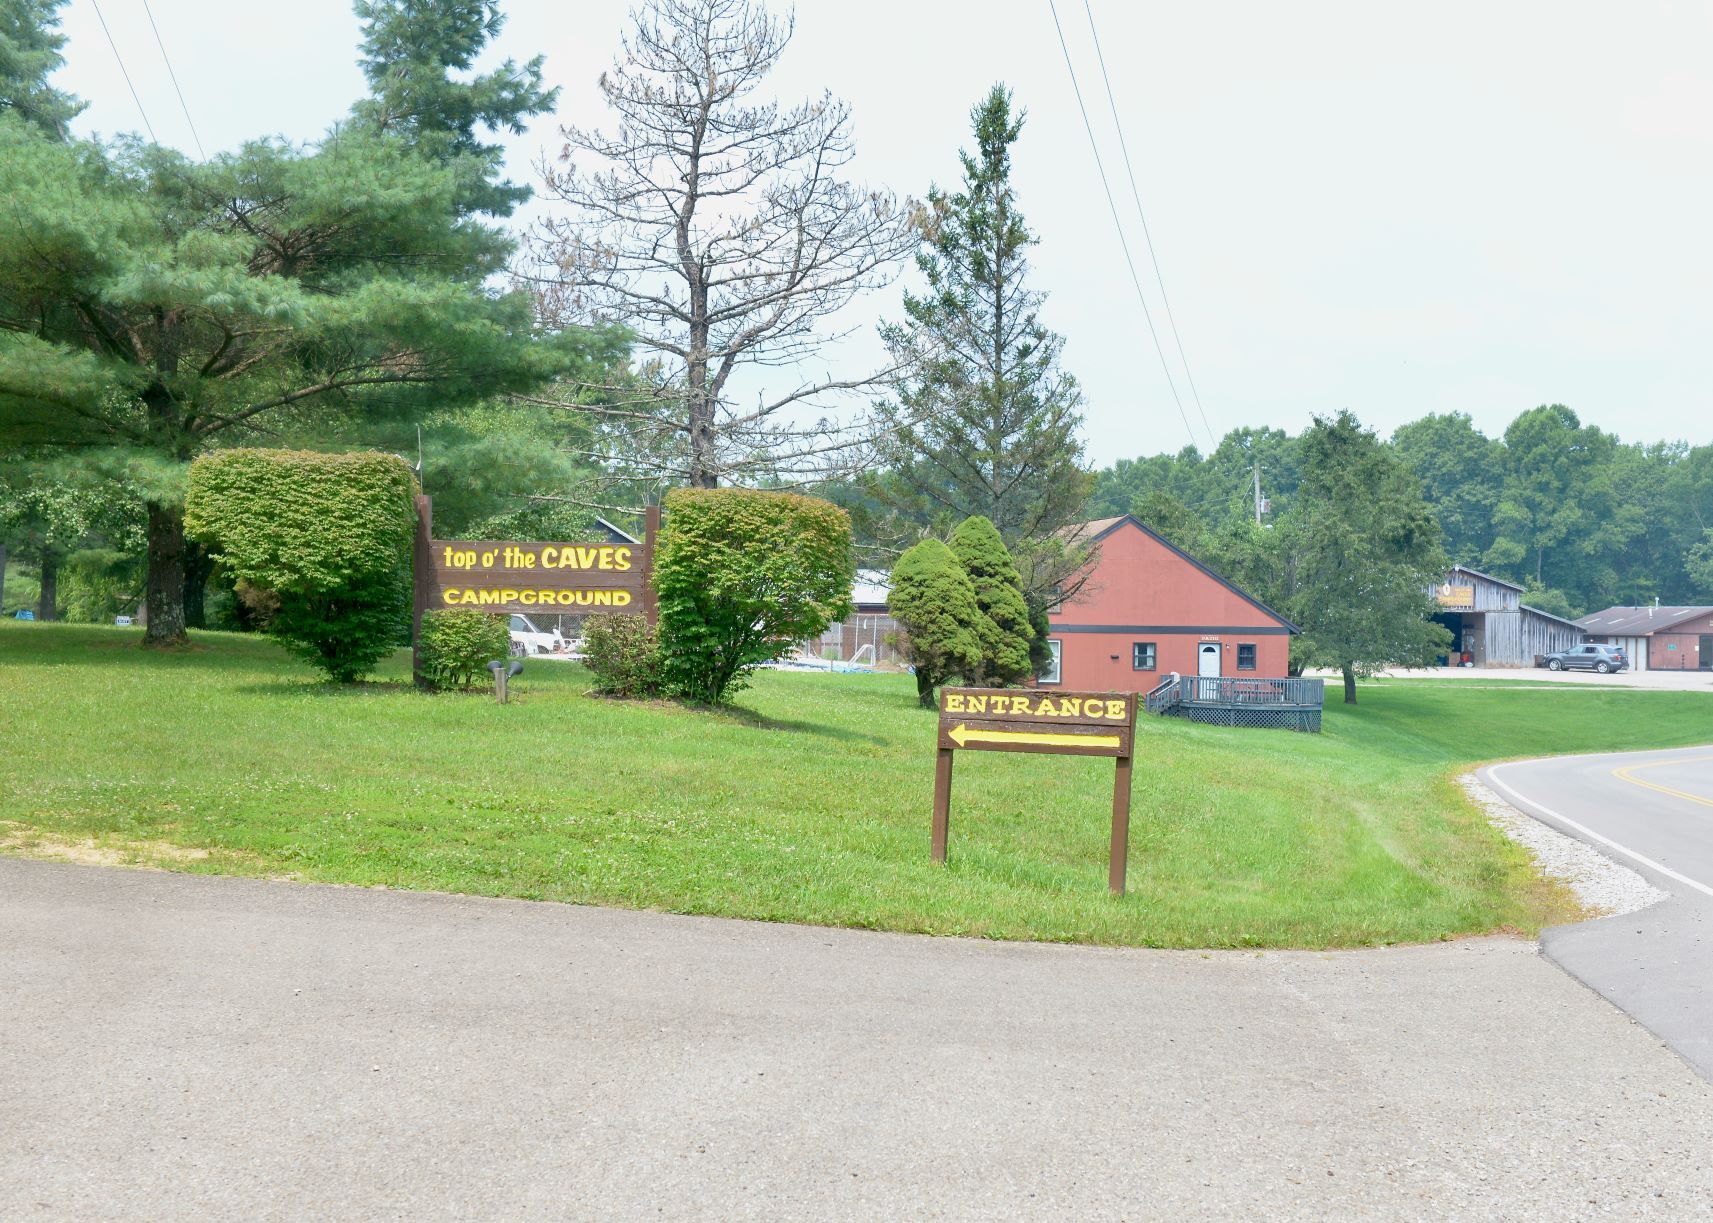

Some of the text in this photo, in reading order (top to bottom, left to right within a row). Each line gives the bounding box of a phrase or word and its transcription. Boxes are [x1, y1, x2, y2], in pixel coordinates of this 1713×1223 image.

[443, 546, 477, 570] top
[502, 546, 536, 569] the
[541, 546, 632, 571] CAVES
[443, 588, 632, 606] CAMPGROUND
[945, 693, 1126, 720] ENTRANCE
